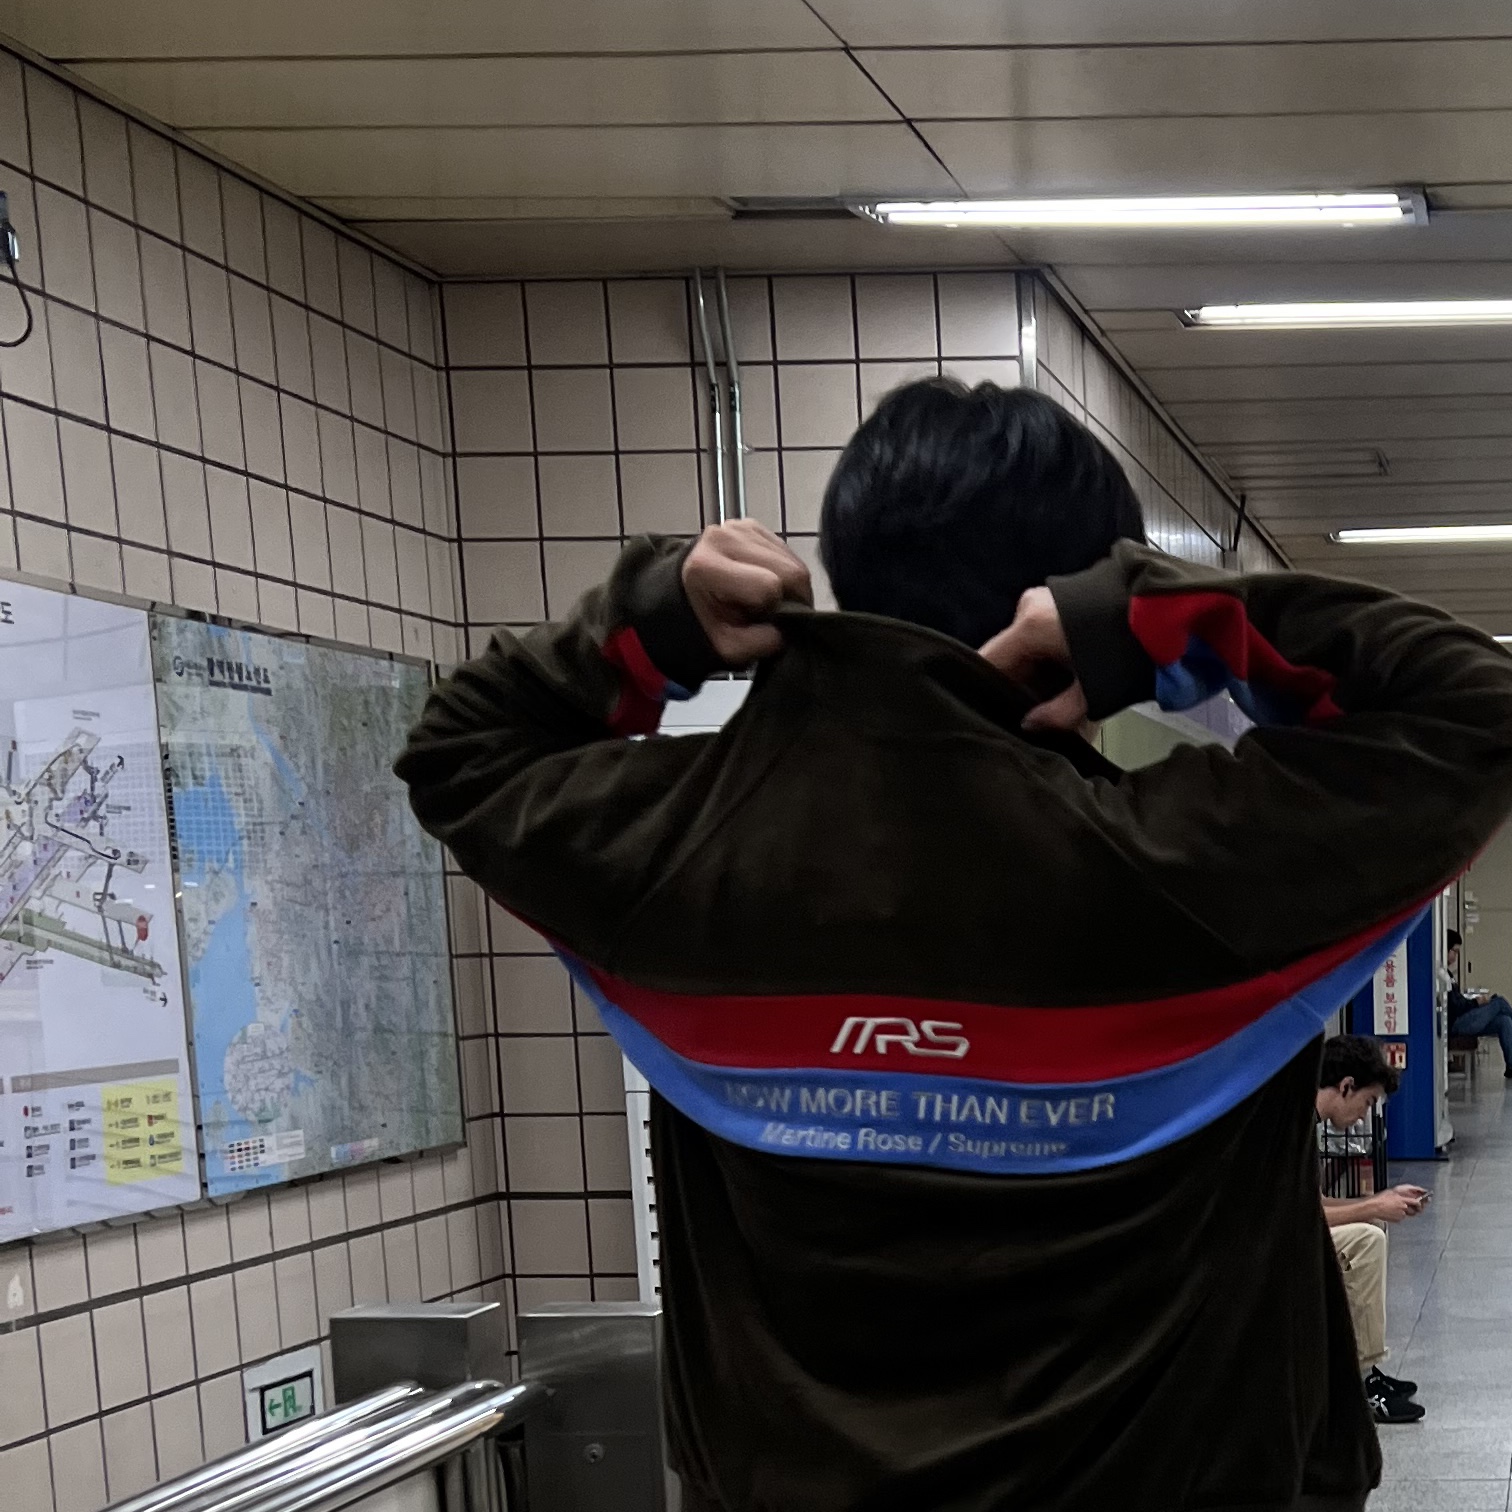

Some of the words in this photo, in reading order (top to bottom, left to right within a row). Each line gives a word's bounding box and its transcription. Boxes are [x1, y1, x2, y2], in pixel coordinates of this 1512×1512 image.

[800, 1087, 899, 1118] MORE
[913, 1091, 1008, 1125] THAN
[1018, 1092, 1116, 1127] EVER
[759, 1121, 852, 1150] Martine
[856, 1127, 924, 1152] Rose
[947, 1132, 1067, 1160] Supreme
